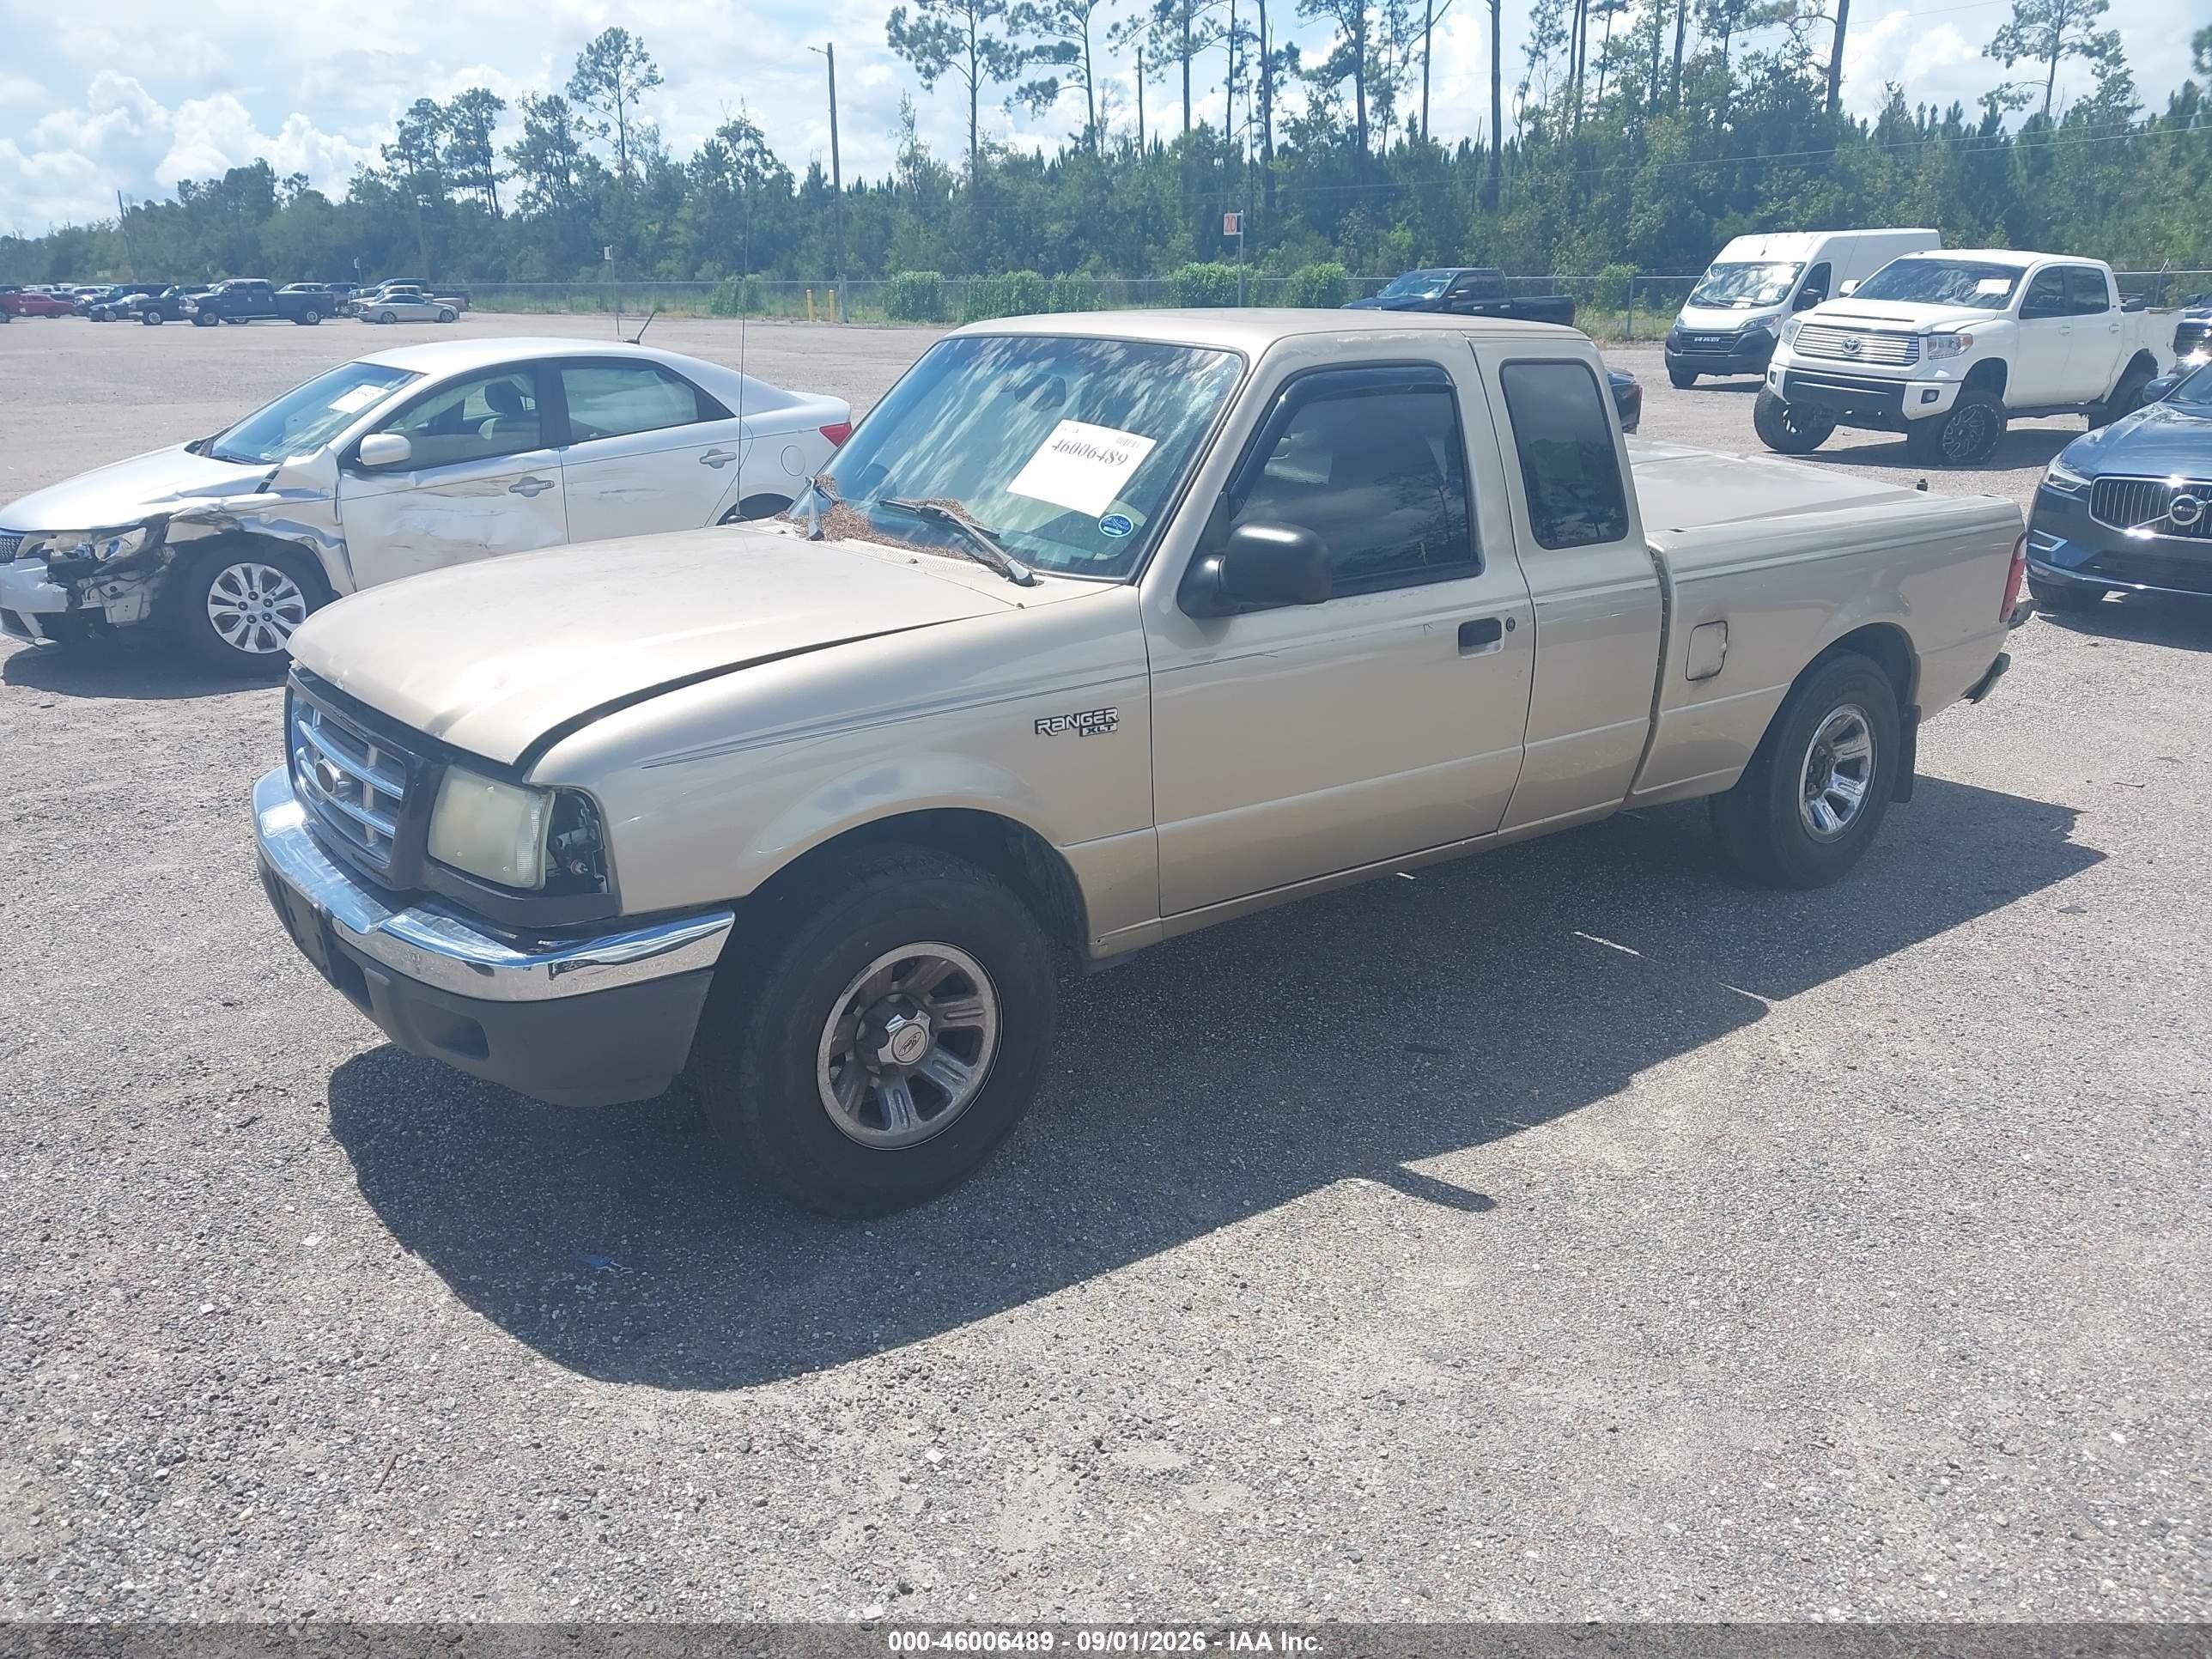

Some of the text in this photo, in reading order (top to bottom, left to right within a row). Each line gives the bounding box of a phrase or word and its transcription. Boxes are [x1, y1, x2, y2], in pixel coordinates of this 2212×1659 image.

[1051, 437, 1129, 467] 46006489
[1035, 707, 1120, 736] RANGER
[1083, 723, 1117, 736] XLT
